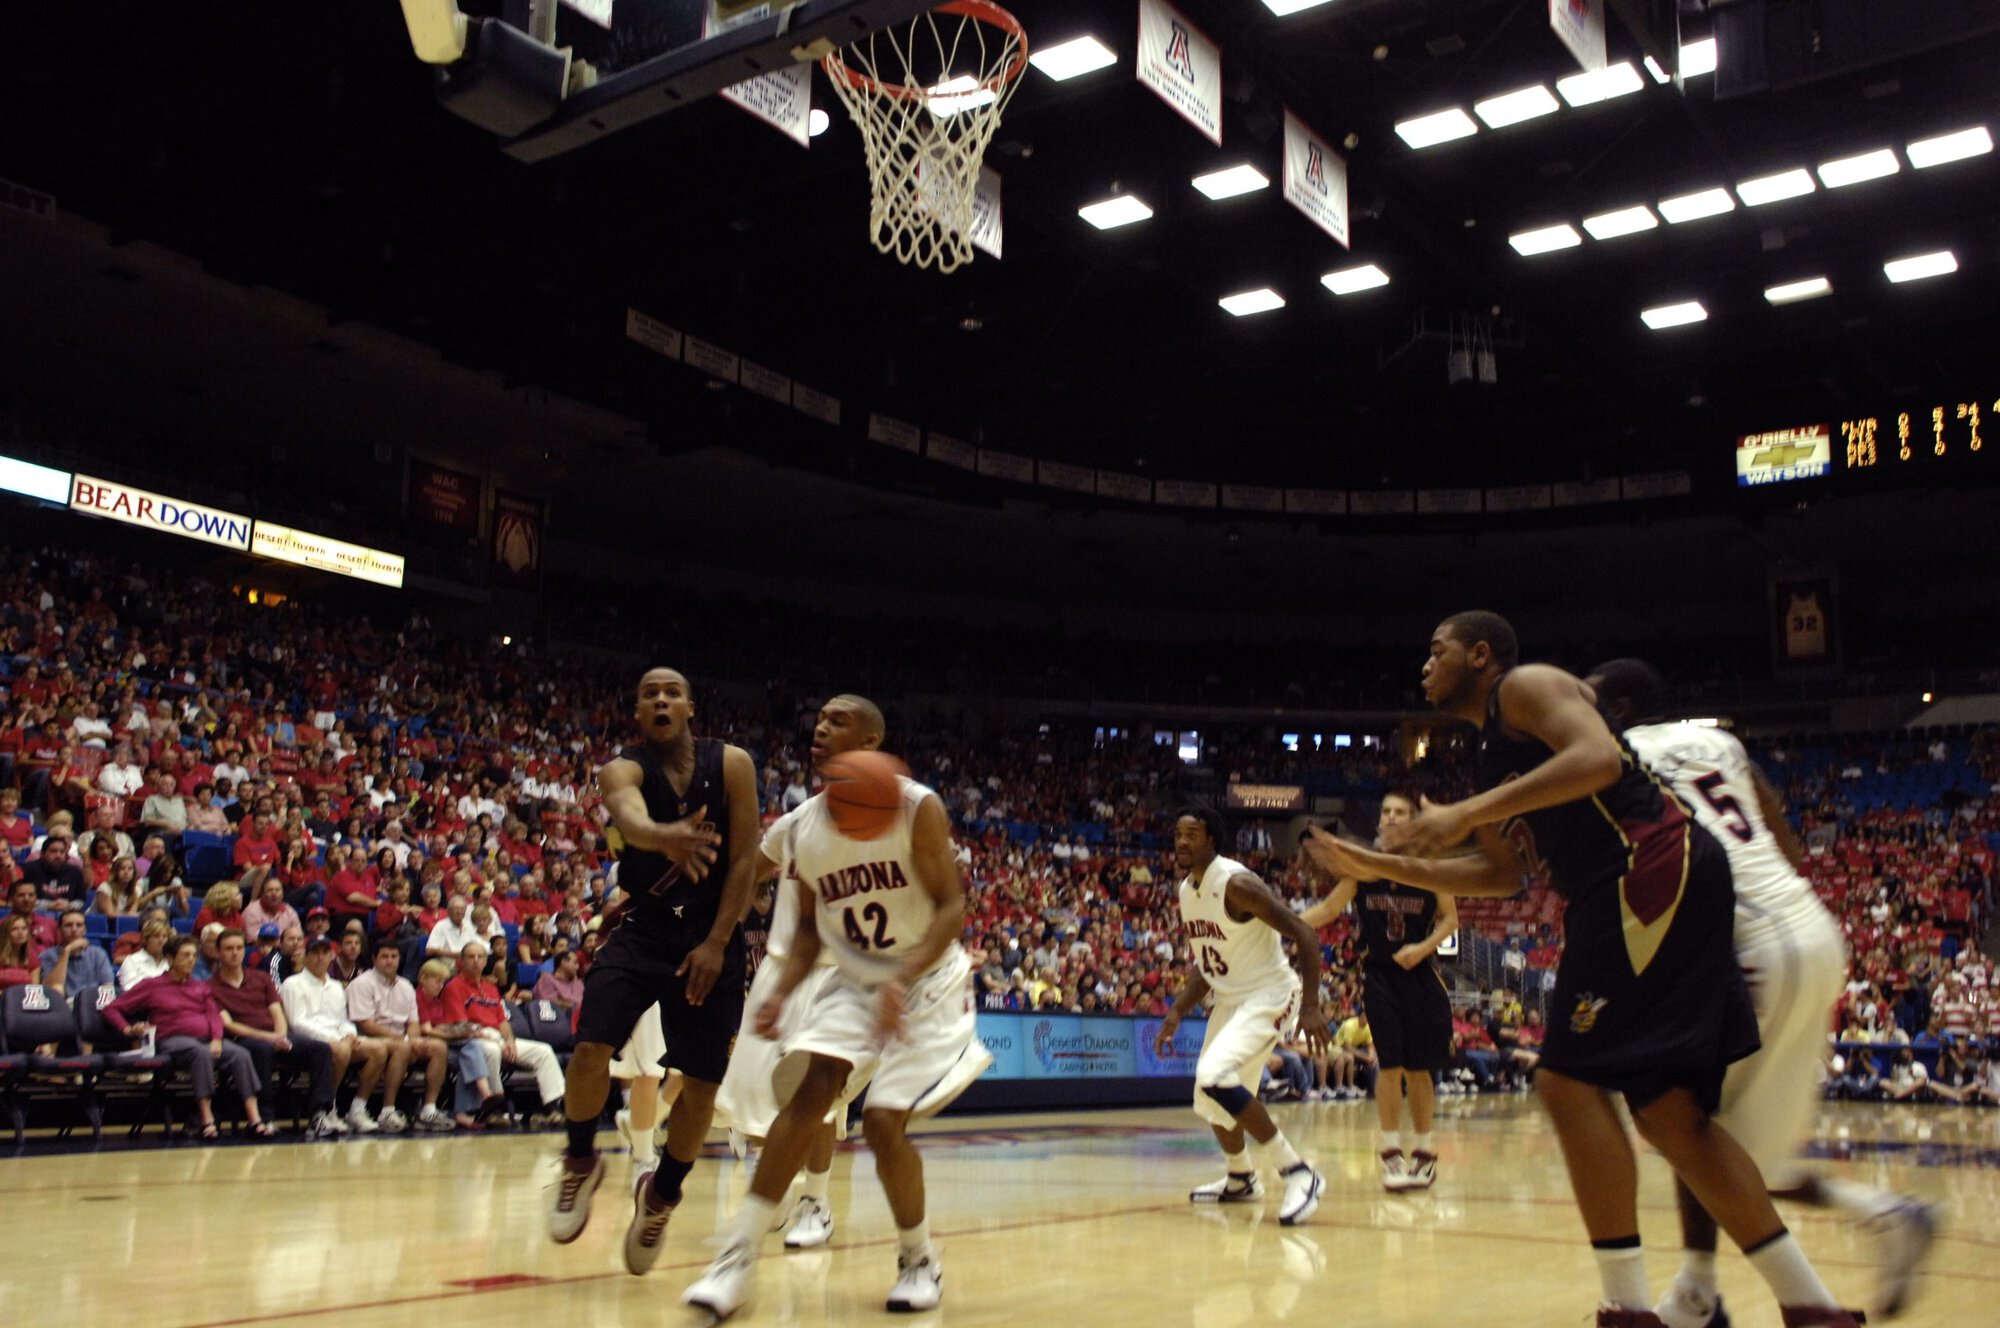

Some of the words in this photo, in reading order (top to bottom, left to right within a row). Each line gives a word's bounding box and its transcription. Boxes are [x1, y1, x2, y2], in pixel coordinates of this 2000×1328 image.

[1744, 425, 1820, 447] O'RIELLY
[1746, 465, 1824, 485] WATSON
[292, 541, 326, 555] TOYOTA
[1793, 615, 1817, 632] 32
[1694, 770, 1752, 842] 5
[817, 860, 908, 904] ARIZONA
[843, 901, 897, 950] 42
[1202, 944, 1229, 977] 43
